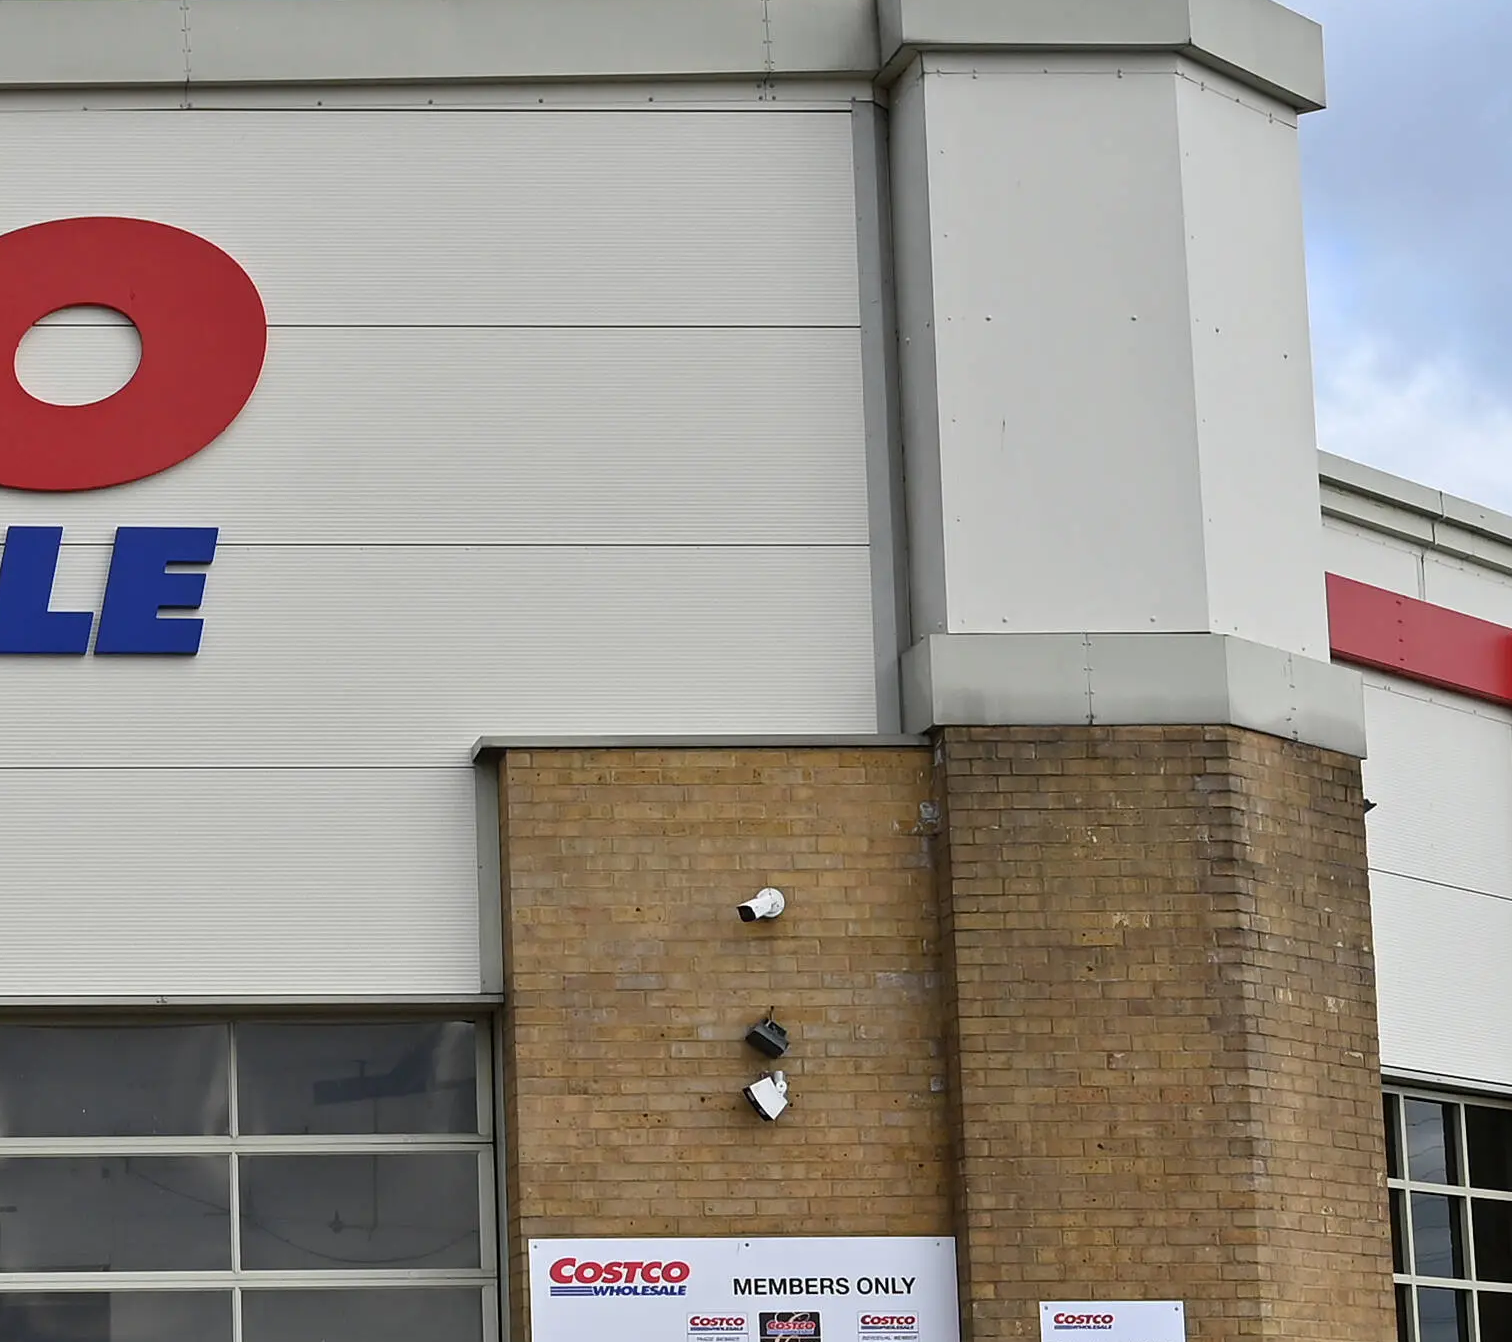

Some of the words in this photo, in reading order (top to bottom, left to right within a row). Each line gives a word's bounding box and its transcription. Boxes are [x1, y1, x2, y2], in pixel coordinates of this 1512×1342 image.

[549, 1258, 690, 1284] COSTCO
[593, 1285, 687, 1296] WHOLESALE
[733, 1278, 850, 1295] MEMBERS
[857, 1278, 916, 1295] ONLY
[690, 1316, 745, 1326] COSTCO
[861, 1315, 915, 1324] COSTCO
[1054, 1313, 1114, 1324] COSTCO
